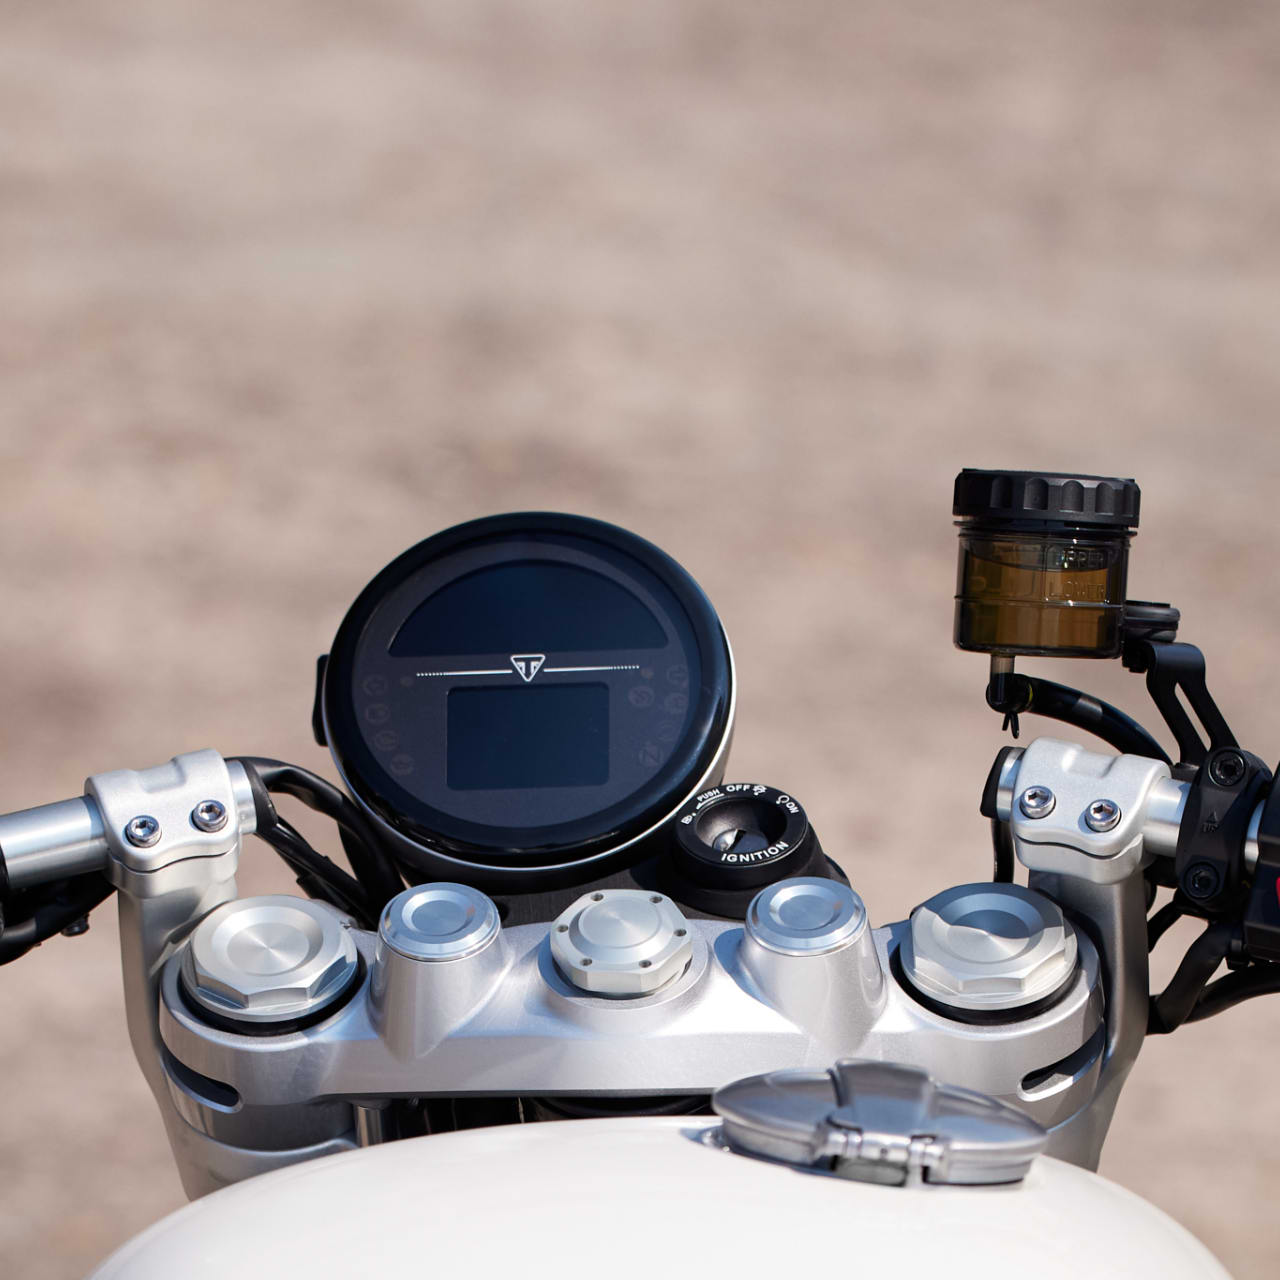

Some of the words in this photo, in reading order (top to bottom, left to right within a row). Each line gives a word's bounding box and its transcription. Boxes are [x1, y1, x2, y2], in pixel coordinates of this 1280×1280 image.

[697, 788, 720, 802] PUSH
[726, 784, 751, 793] OFF
[787, 802, 800, 815] ON
[721, 841, 790, 863] IGNITION
